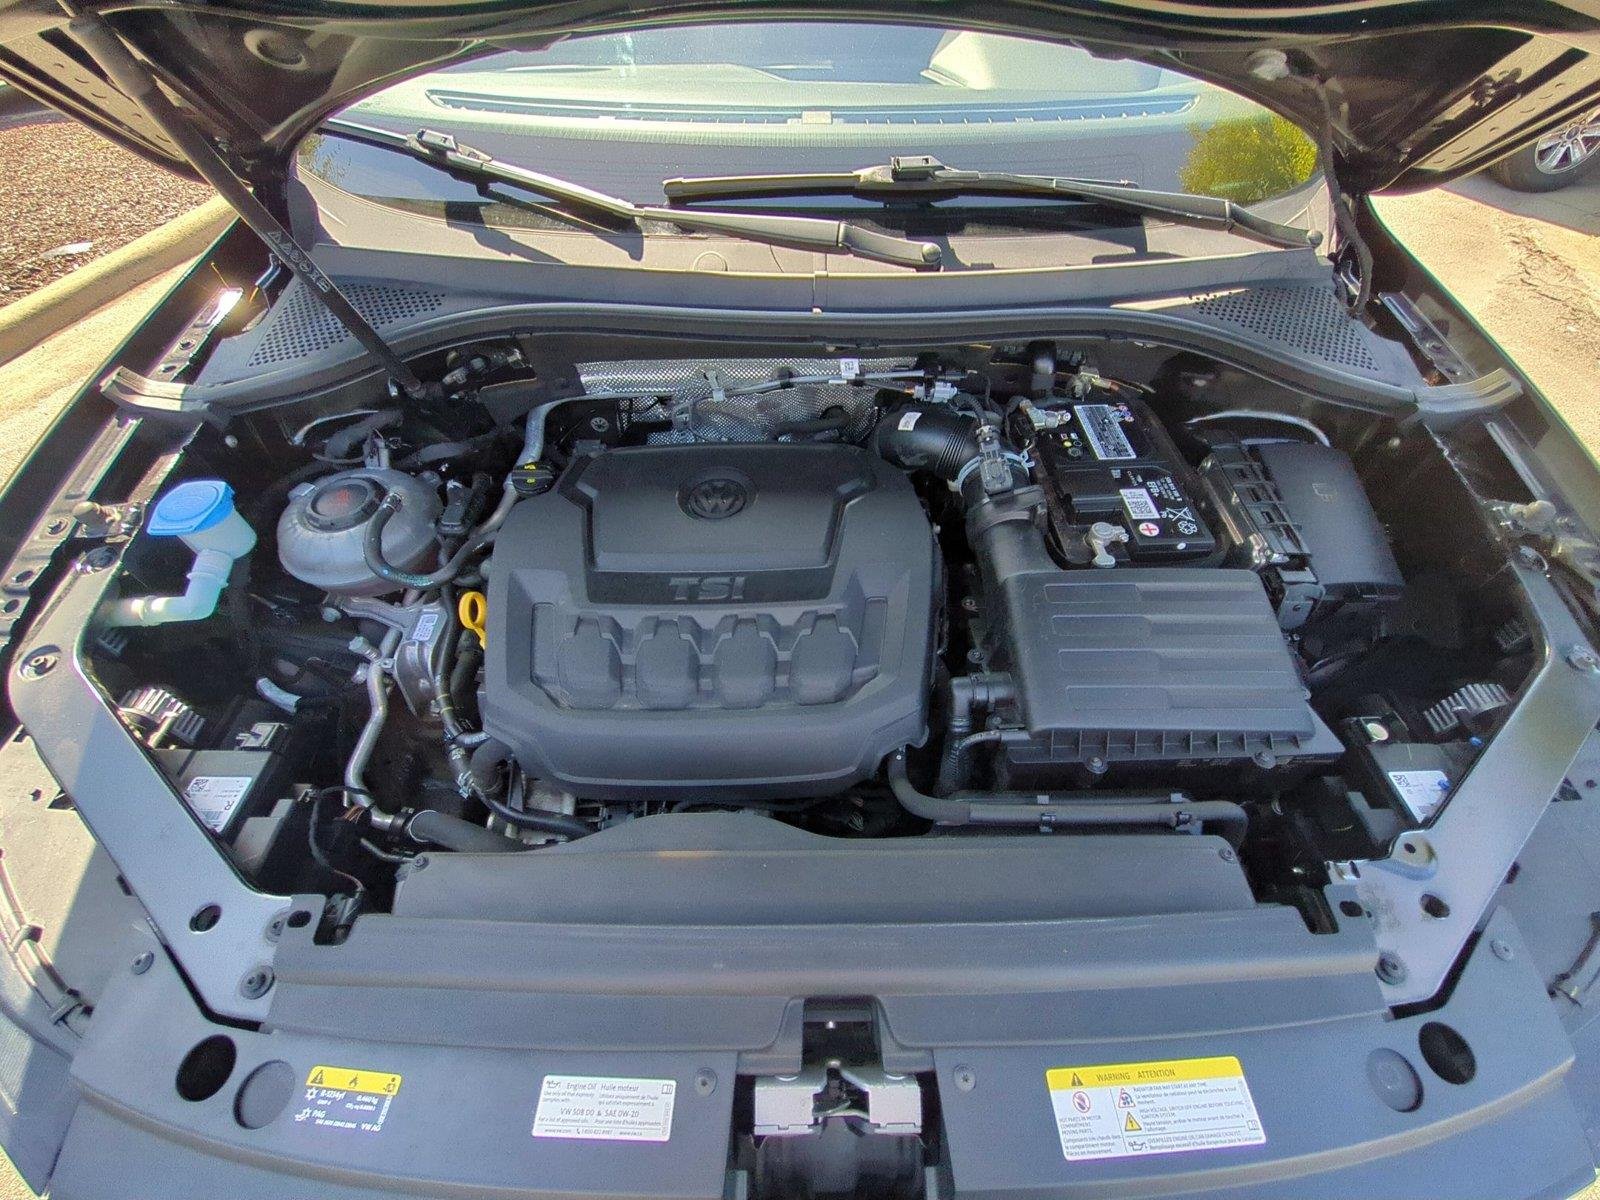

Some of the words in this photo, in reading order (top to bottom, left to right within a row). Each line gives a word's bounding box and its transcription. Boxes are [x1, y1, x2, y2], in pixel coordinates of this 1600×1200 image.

[669, 576, 745, 600] TSI
[1096, 1072, 1131, 1083] WARNING
[1137, 1069, 1176, 1079] ATTENTION
[566, 1082, 587, 1090] Engine
[600, 1083, 616, 1091] Huile
[617, 1084, 640, 1092] moteur
[320, 1089, 347, 1101] R-1234yf
[312, 1110, 326, 1119] PAG
[561, 1107, 572, 1115] VW
[572, 1108, 585, 1116] 508
[604, 1109, 617, 1117] SAE
[618, 1109, 640, 1118] 0W-20
[361, 1122, 371, 1131] VW
